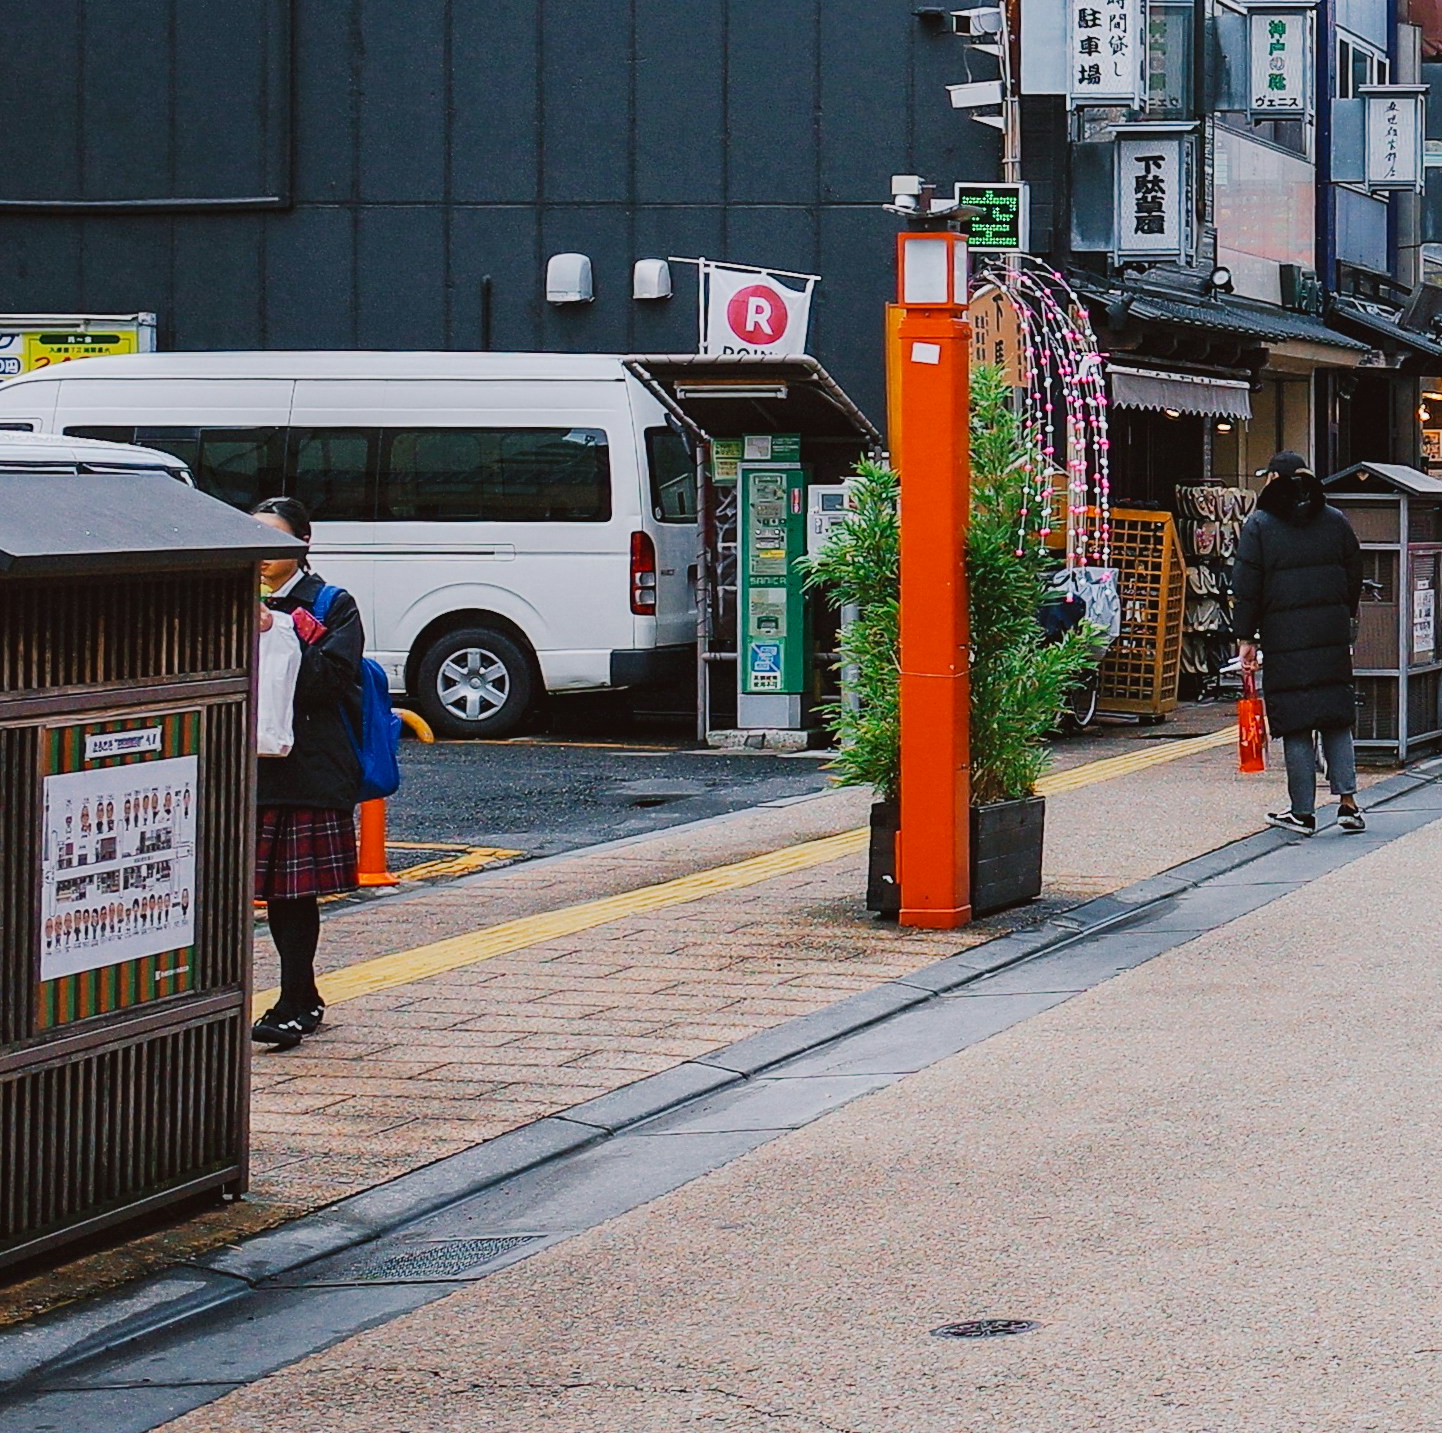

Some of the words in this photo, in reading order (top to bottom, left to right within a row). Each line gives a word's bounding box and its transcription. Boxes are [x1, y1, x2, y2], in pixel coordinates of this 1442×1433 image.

[1077, 7, 1102, 86] 駐車場
[1255, 94, 1299, 108] ヴェニス
[745, 296, 774, 335] R
